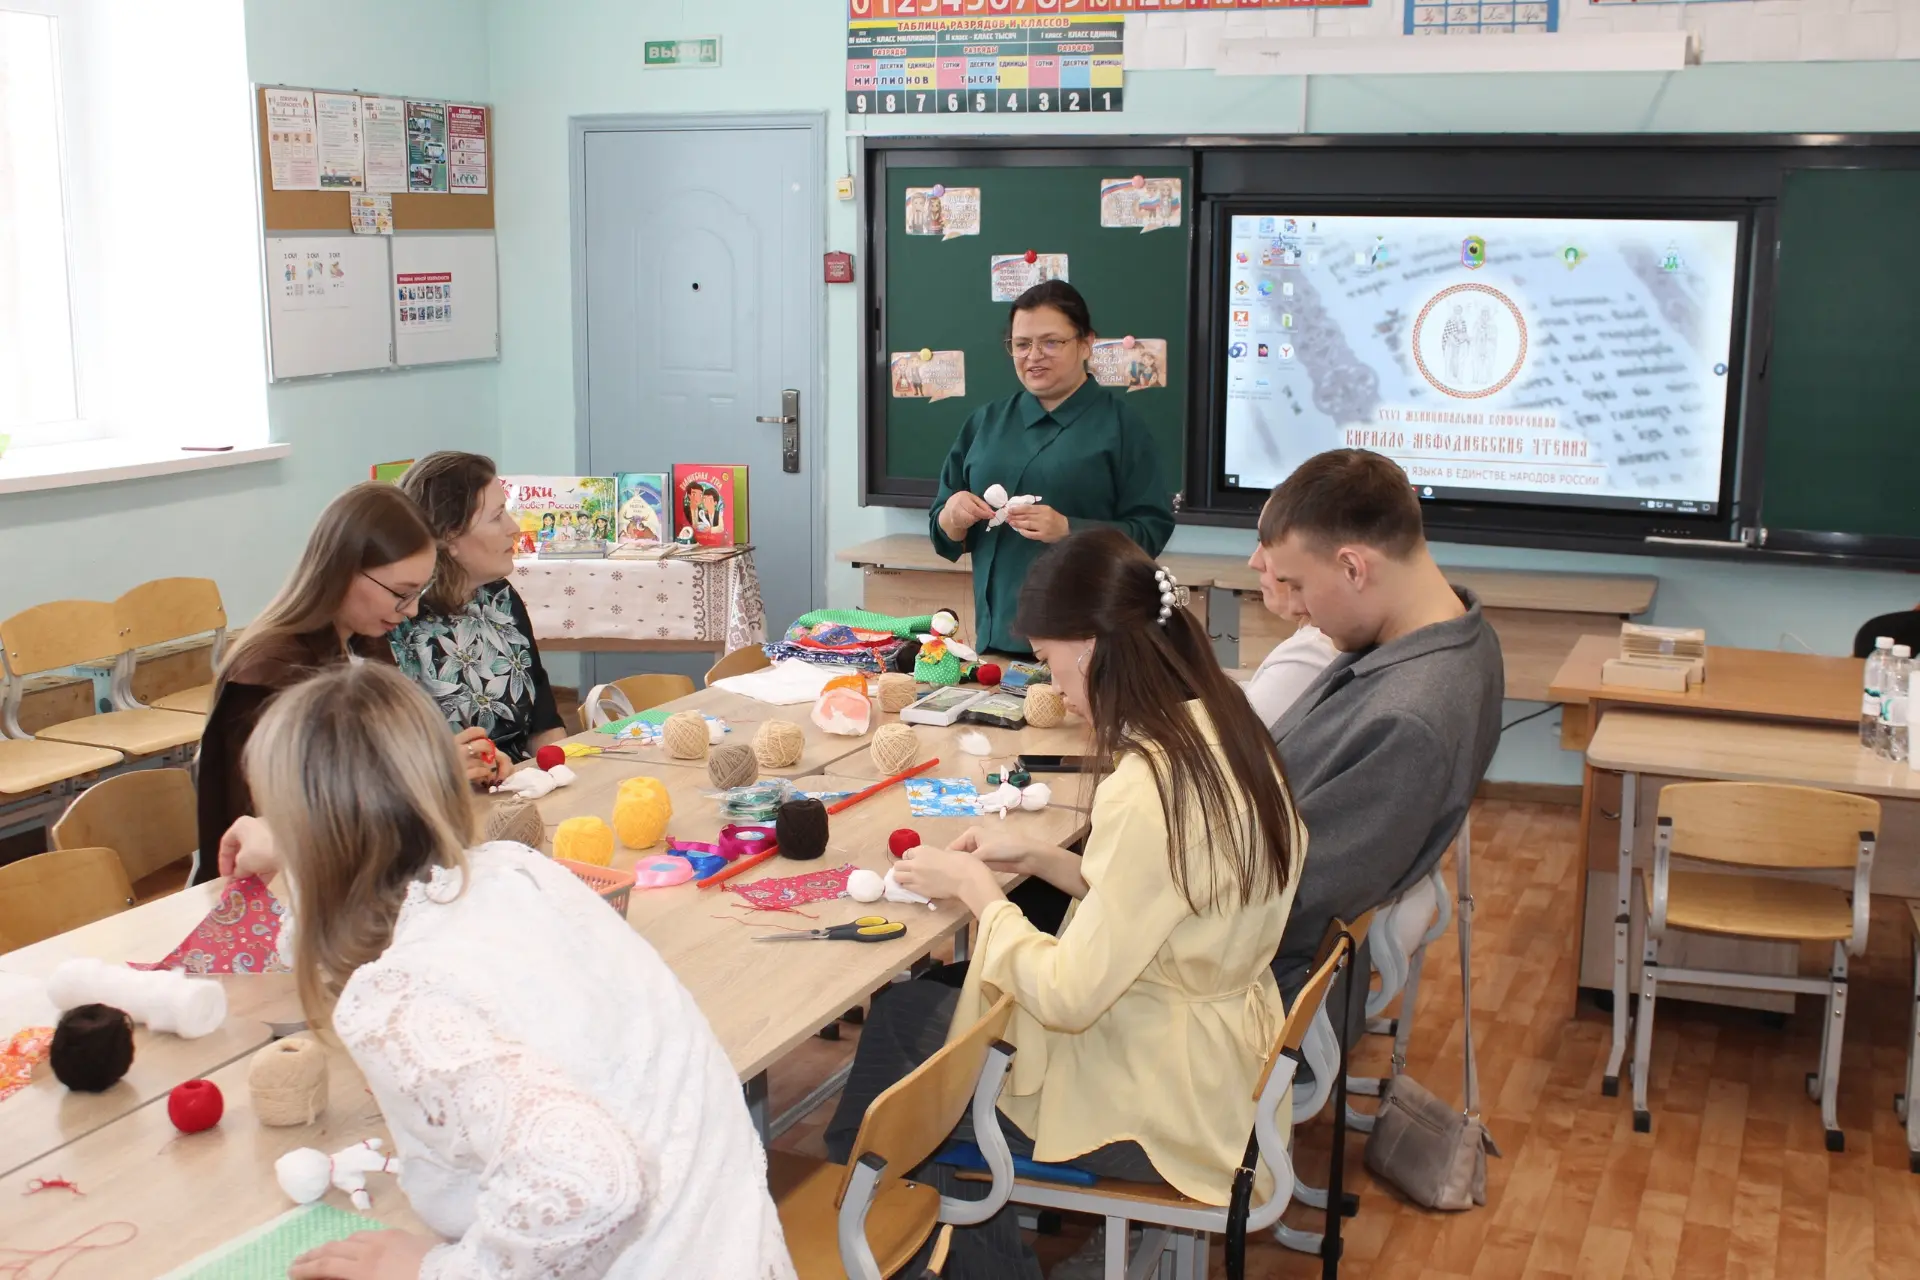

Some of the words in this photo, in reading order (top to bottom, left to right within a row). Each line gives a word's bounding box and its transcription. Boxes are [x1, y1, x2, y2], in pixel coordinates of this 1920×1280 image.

[898, 22, 946, 30] ТАБЛИЦА
[951, 20, 1005, 29] РАЗРЯДОВ
[1021, 18, 1070, 28] КЛАССОВ
[1058, 44, 1094, 52] РАЗРЯДЫ
[855, 76, 929, 85] МИЛЛИОНОВ
[960, 75, 1001, 84] ТЫСЯЧ
[857, 95, 867, 112] 9
[886, 94, 896, 112] 8
[916, 94, 926, 112] 7
[948, 93, 958, 112] 6
[976, 93, 986, 111] 5
[1007, 93, 1018, 111] 4
[1039, 93, 1049, 111] 3
[1069, 92, 1080, 111] 2
[1103, 92, 1111, 110] 1
[1379, 409, 1400, 421] XXVI
[1405, 410, 1483, 425] МУНИЦИПАЛЬНАЯ
[1489, 414, 1556, 429] КОНФЕРЕНЦИЯ
[1533, 438, 1588, 457] ЧТЕНИЯ
[1412, 466, 1443, 476] ЯЗЫКА
[1447, 467, 1453, 477] В
[1457, 468, 1506, 480] ЕДИНСТВЕ
[1510, 472, 1555, 484] НАРОДОВ
[1560, 474, 1600, 485] РОССИИ
[549, 501, 580, 509] Россия
